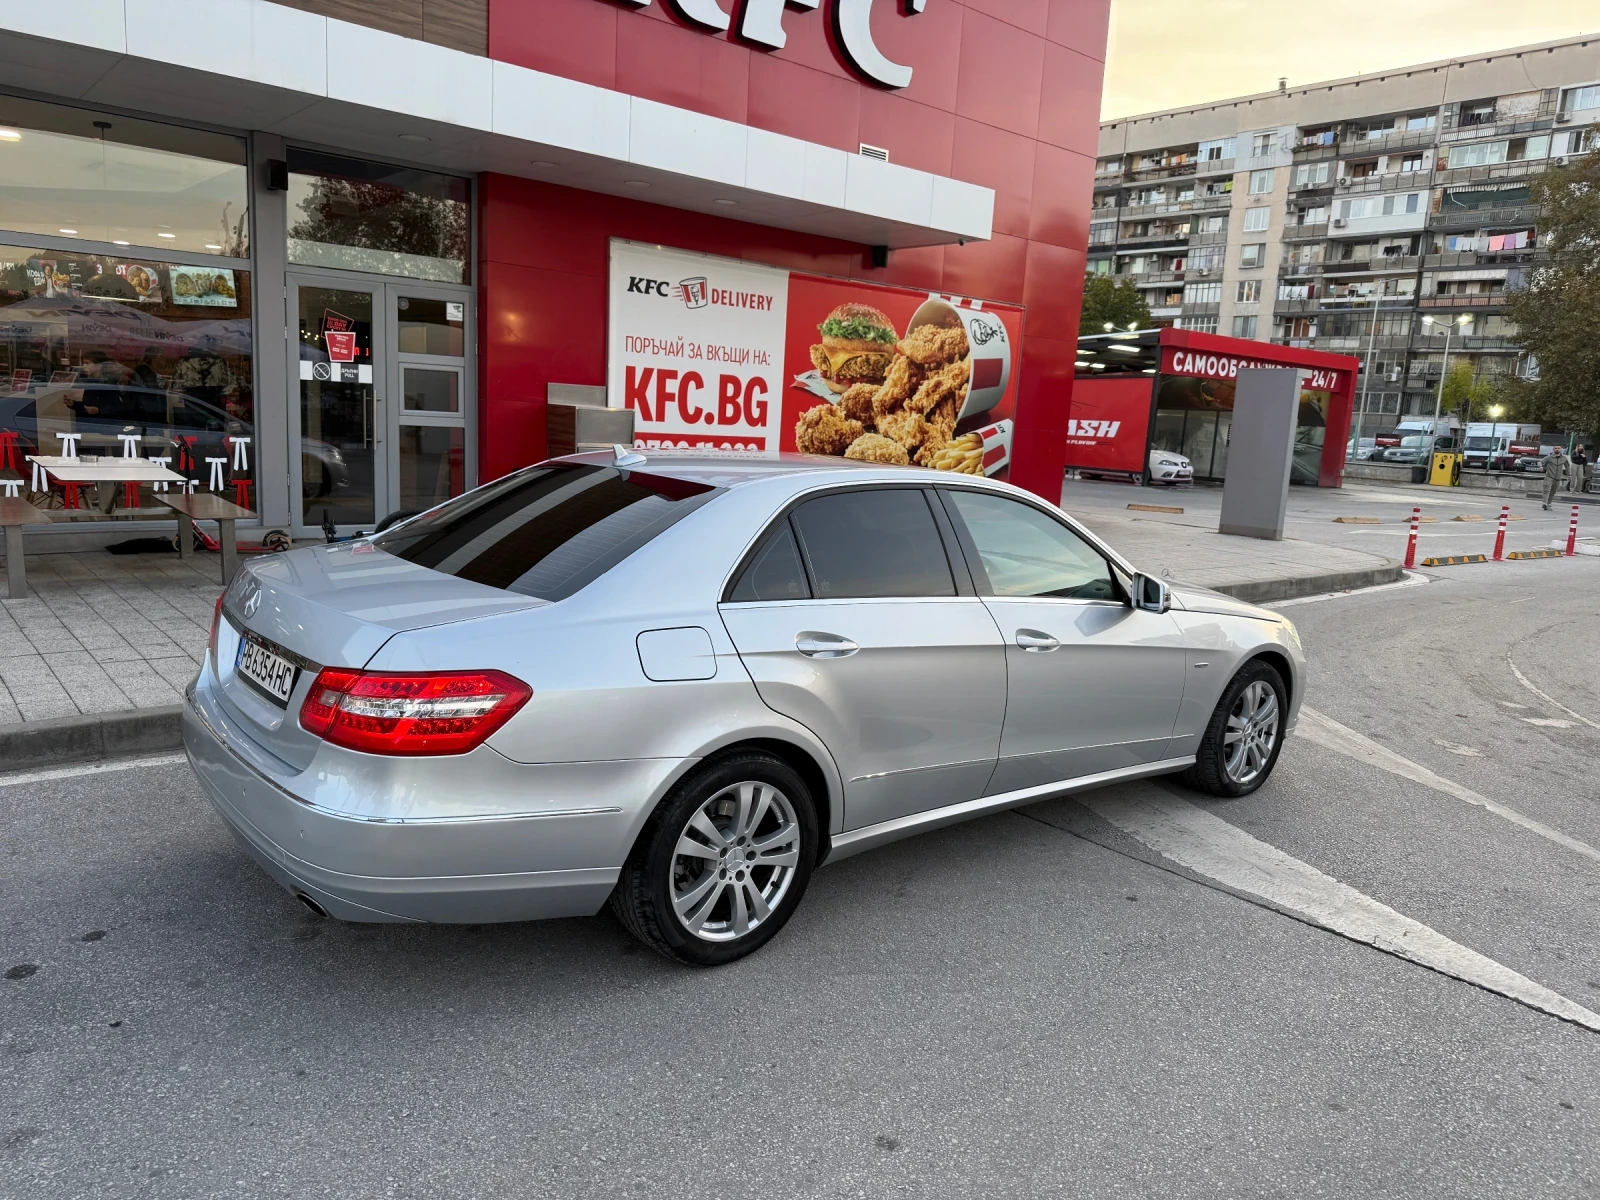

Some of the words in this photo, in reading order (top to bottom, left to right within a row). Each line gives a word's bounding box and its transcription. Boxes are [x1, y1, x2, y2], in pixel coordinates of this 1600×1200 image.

[627, 276, 670, 297] KFC
[711, 287, 773, 311] DELIVERY
[625, 335, 685, 358] ПОРЪЧАЙ
[688, 342, 703, 359] ЗА
[706, 344, 750, 366] ВКЪЩИ
[753, 349, 771, 366] НА:
[1311, 369, 1338, 389] 24/7
[624, 365, 768, 428] KFC.BG
[1067, 419, 1121, 438] ASH
